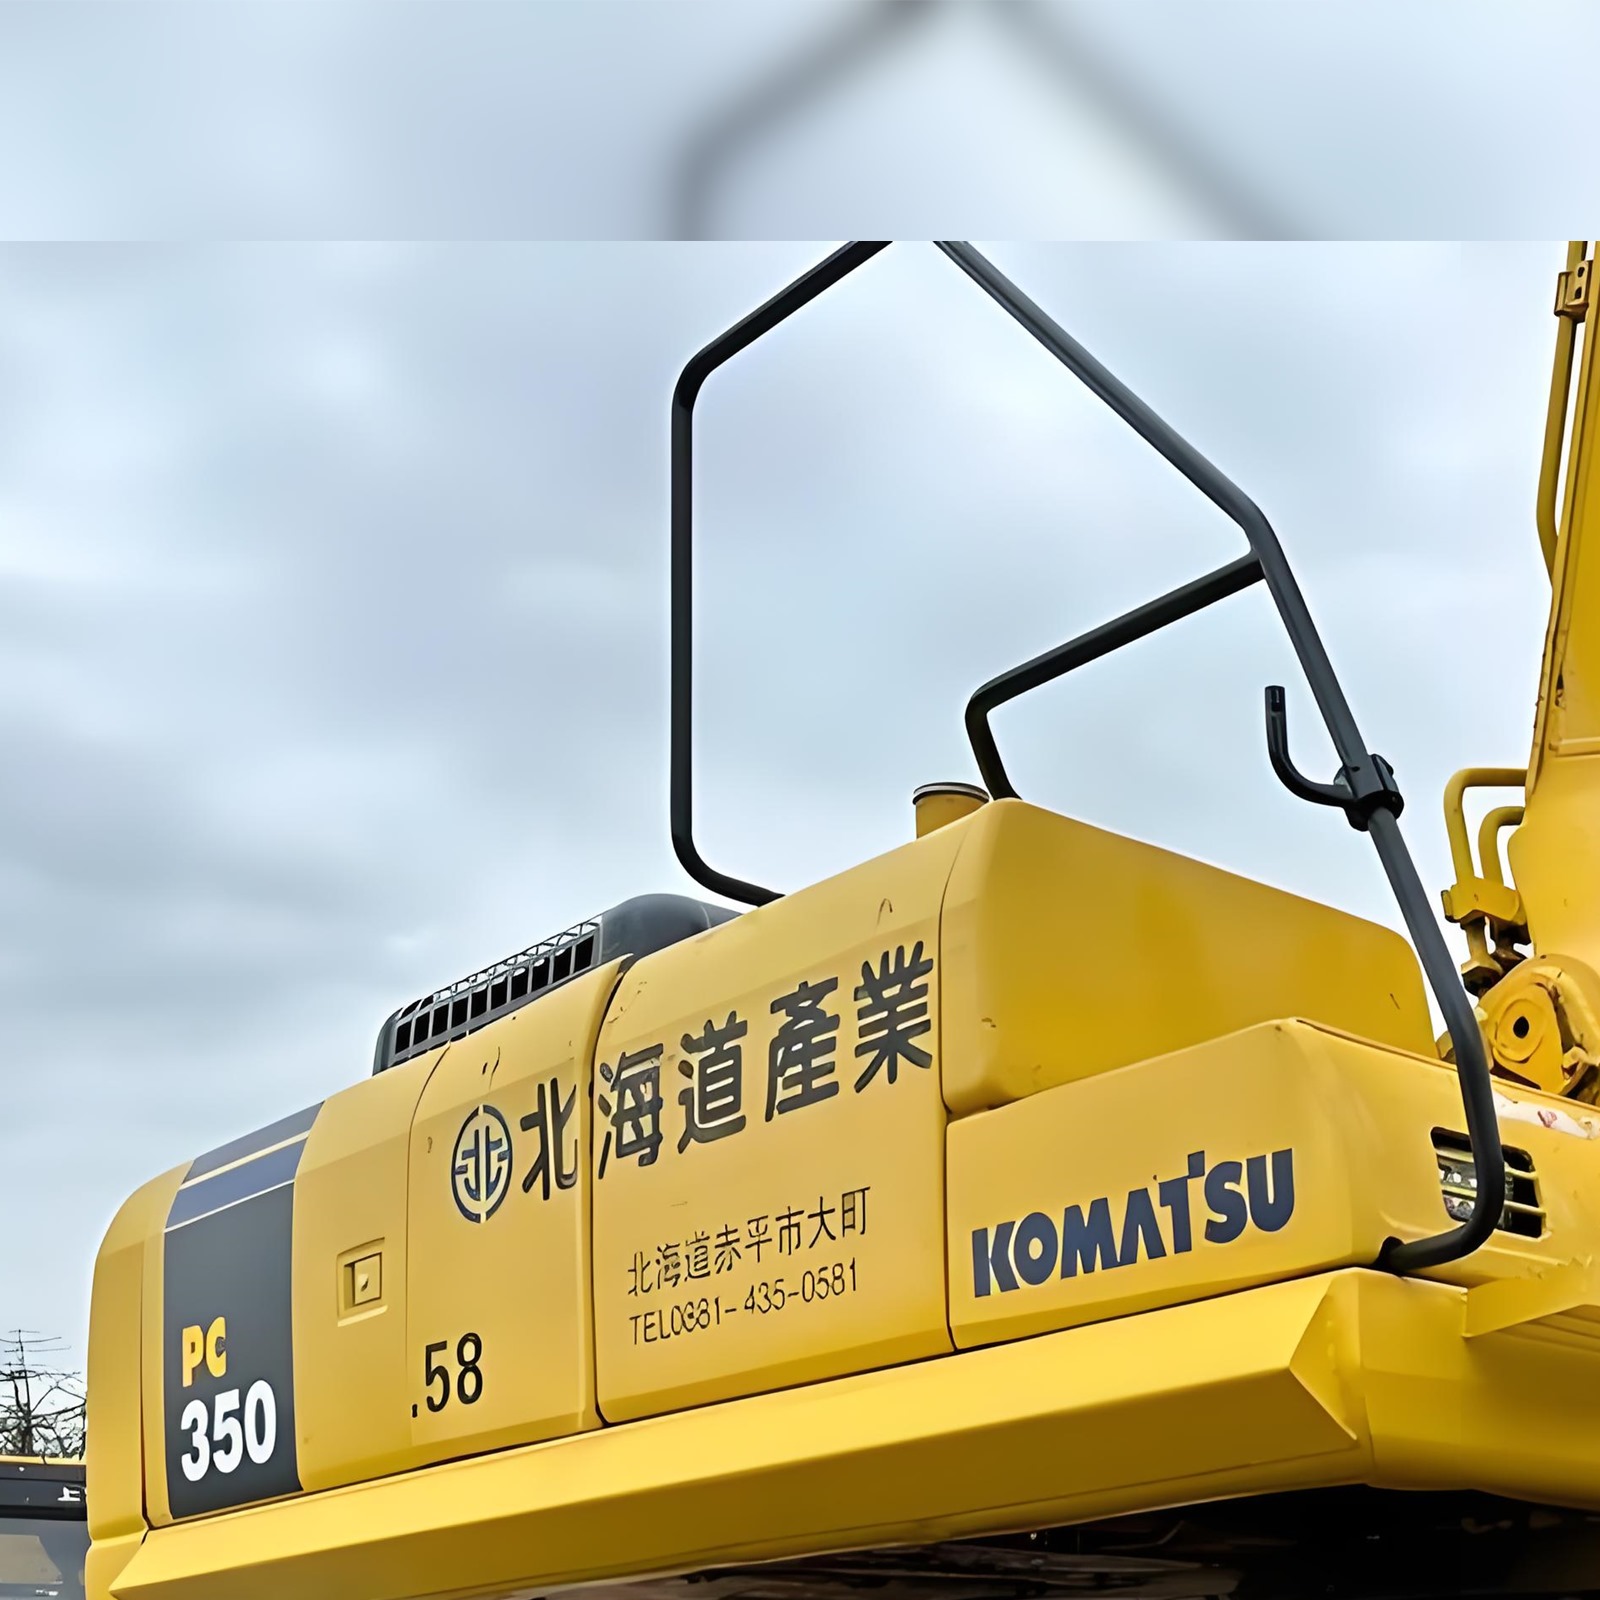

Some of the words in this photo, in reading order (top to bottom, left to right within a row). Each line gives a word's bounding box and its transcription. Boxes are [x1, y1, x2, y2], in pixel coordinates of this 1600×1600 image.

[972, 1148, 1295, 1298] KOMATSU
[182, 1316, 227, 1388] PC
[180, 1379, 277, 1482] 350
